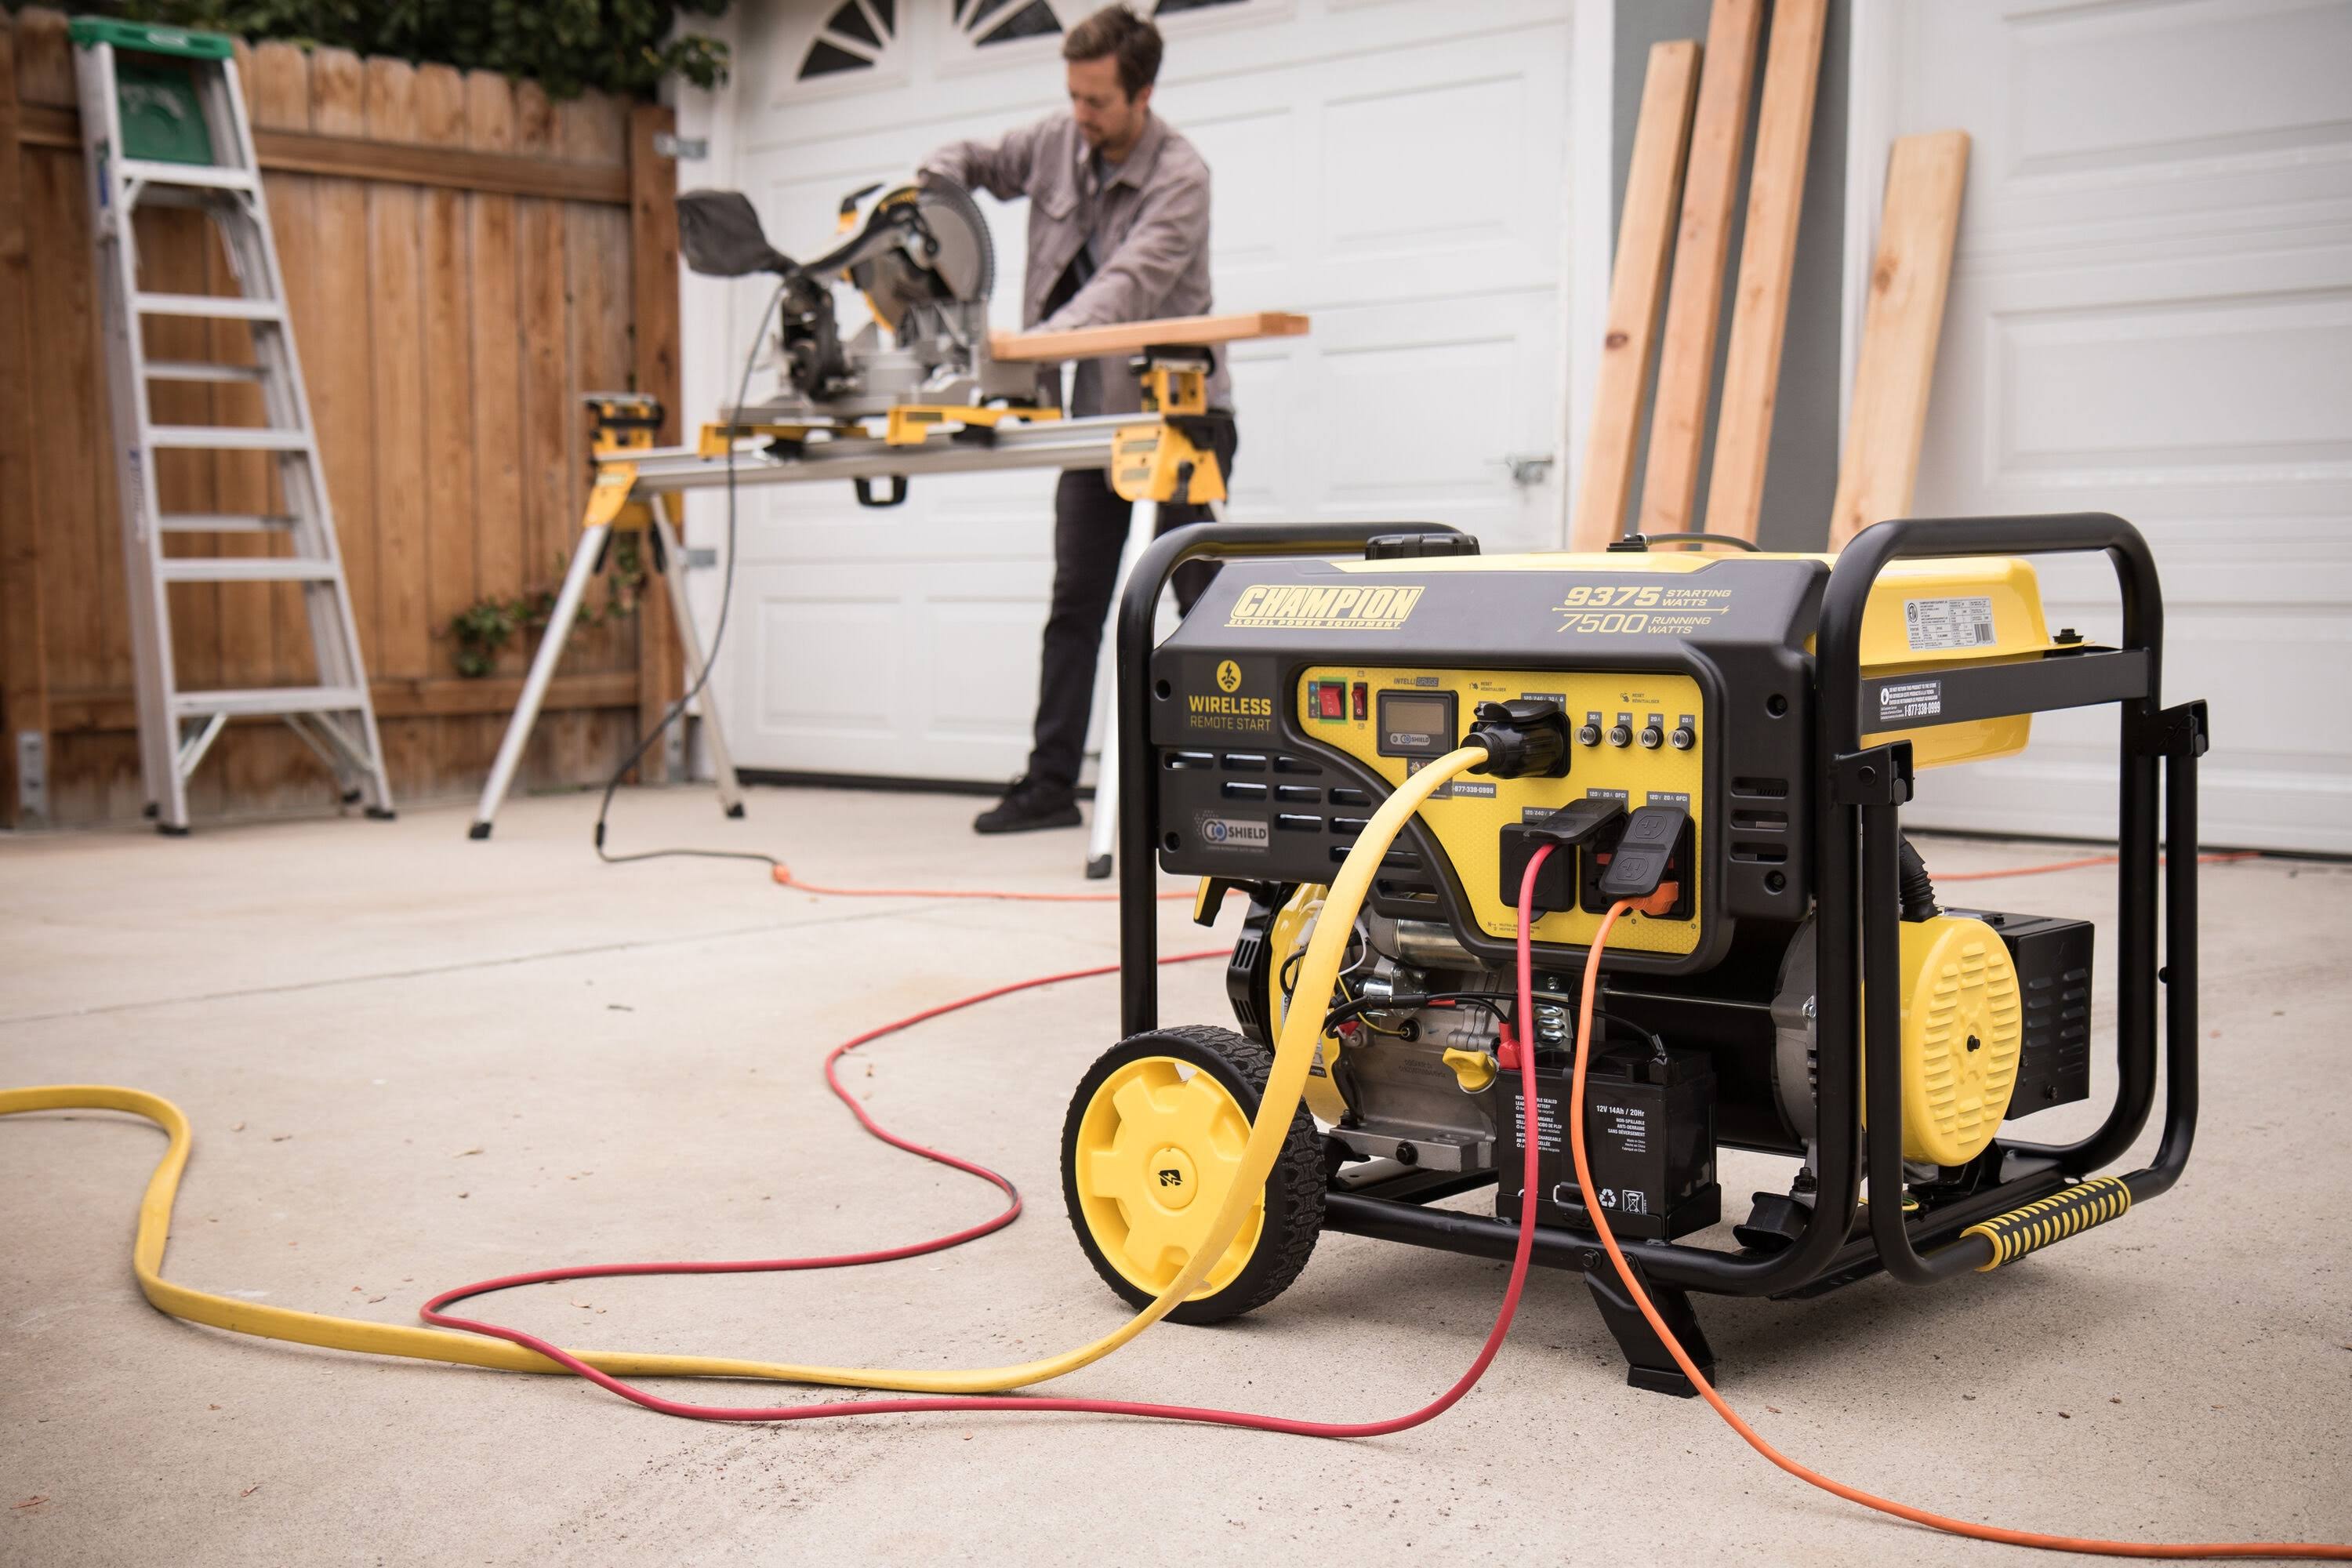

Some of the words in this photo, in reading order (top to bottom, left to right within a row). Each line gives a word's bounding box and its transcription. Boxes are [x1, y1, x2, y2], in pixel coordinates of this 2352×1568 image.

[1231, 586, 1425, 620] CHAMPION
[1564, 586, 1664, 606] 9375
[1556, 613, 1649, 633] 7500
[1651, 616, 1711, 625] RUNNING
[1647, 626, 1693, 634] WATTS
[1189, 695, 1272, 716] WIRELESS
[1904, 701, 1940, 717] 1-877-338-0999
[1190, 715, 1234, 730] REMOTE
[1236, 717, 1272, 731] START
[1411, 735, 1429, 743] SHIELD
[1228, 826, 1267, 840] SHIELD
[1609, 1106, 1624, 1115] 14Ah
[1630, 1109, 1645, 1117] 20Hr
